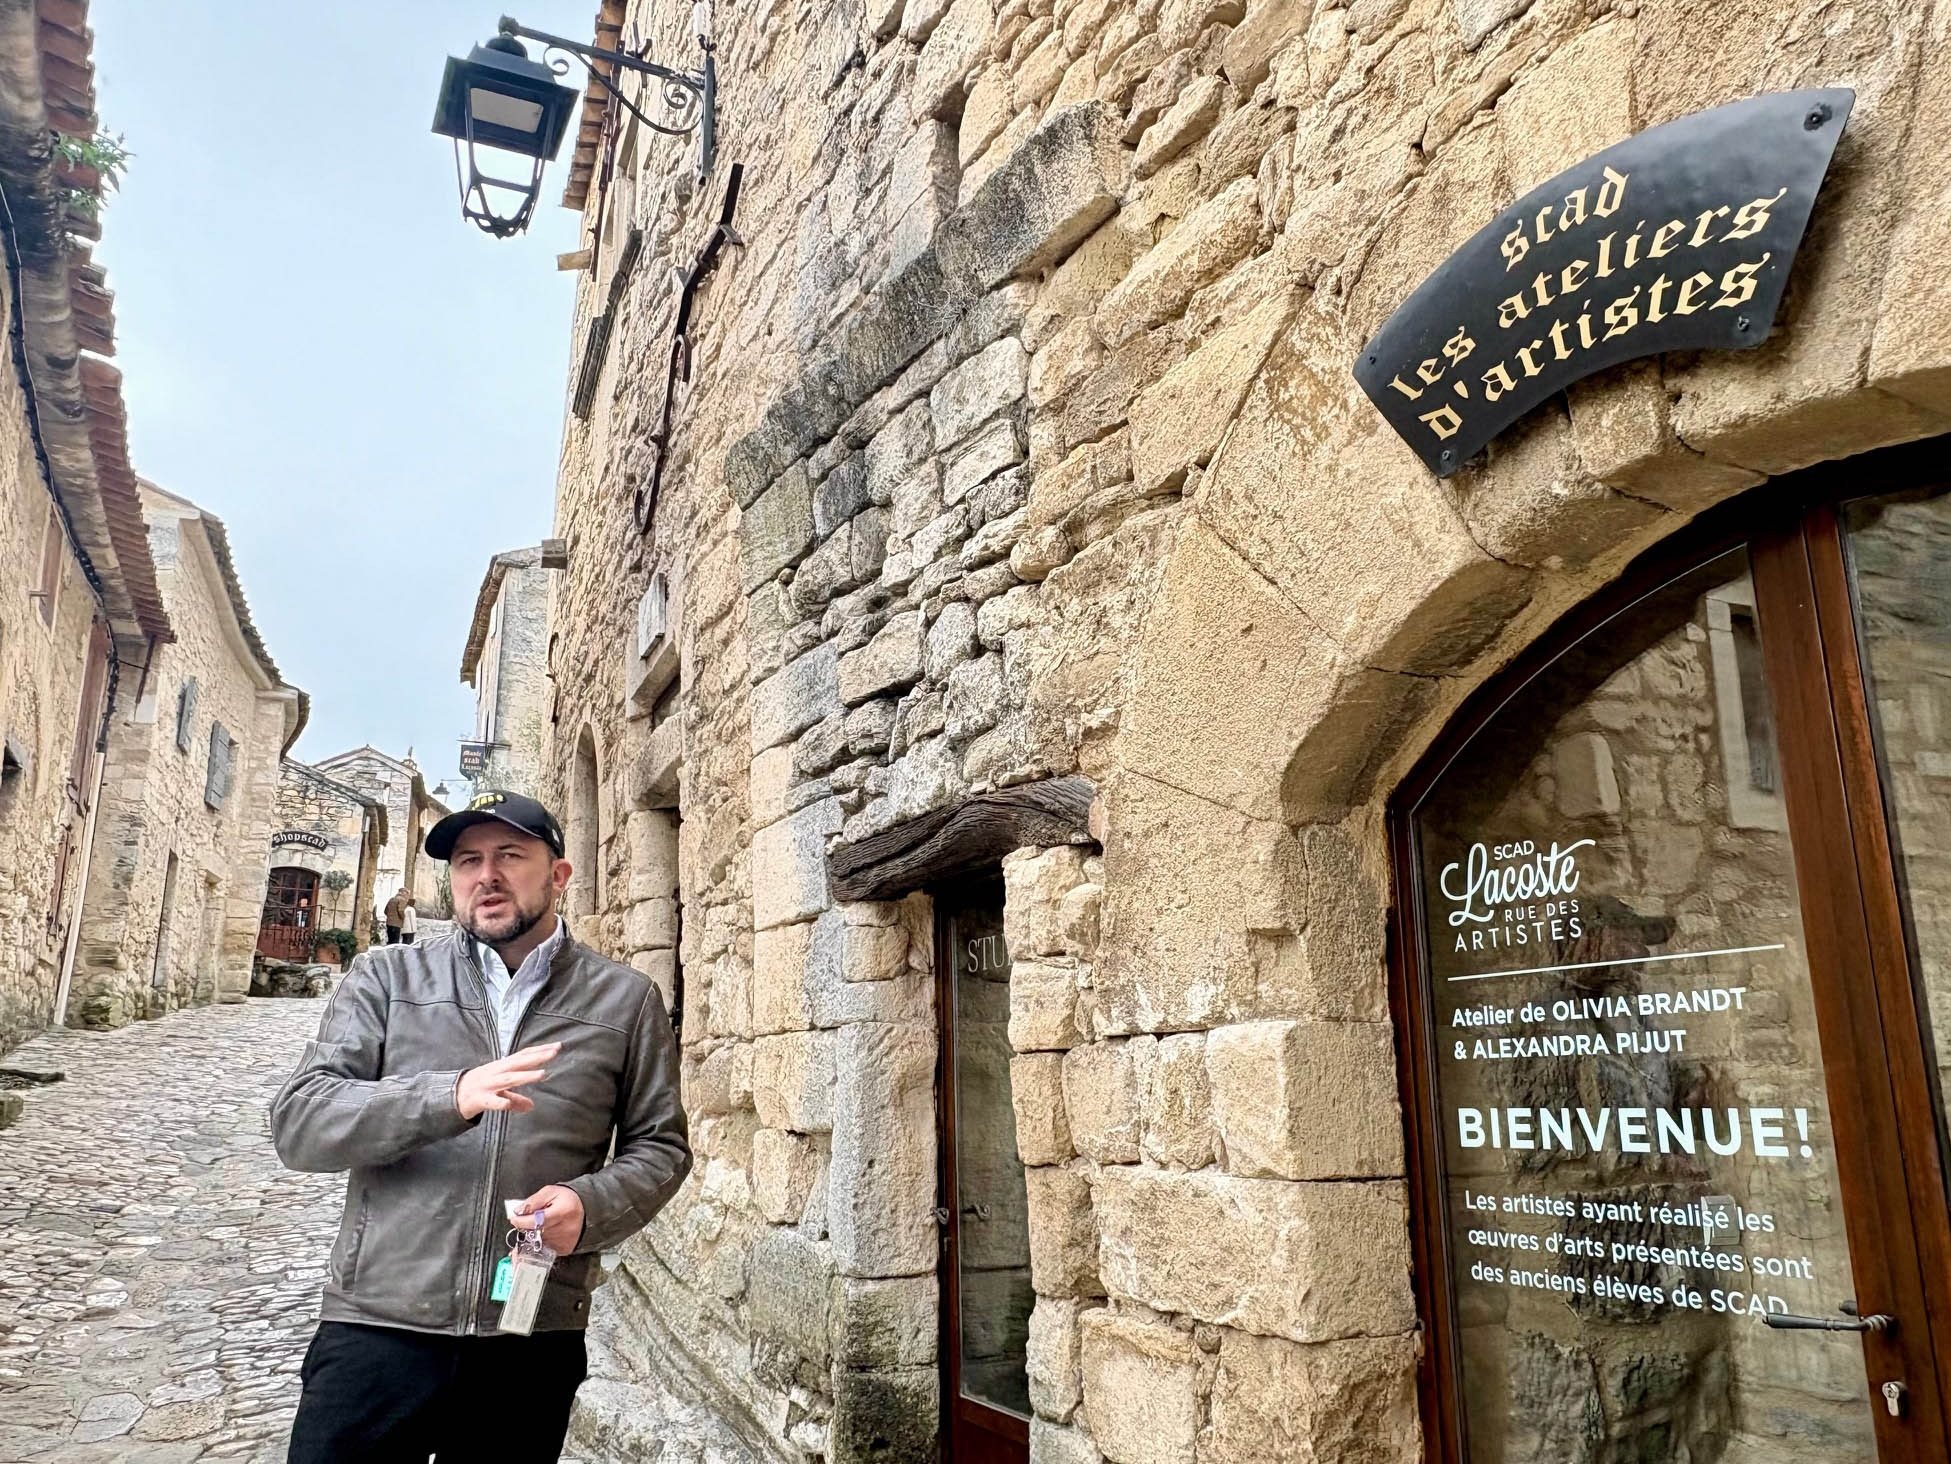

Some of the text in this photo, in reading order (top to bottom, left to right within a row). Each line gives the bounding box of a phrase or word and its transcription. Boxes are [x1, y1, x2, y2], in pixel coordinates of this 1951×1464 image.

[1500, 166, 1629, 272] scad
[1387, 187, 1788, 401] les ateliers
[1419, 252, 1771, 440] d'artistes
[1494, 840, 1535, 860] SCAD
[1440, 839, 1596, 926] Lacoste
[1505, 900, 1579, 922] RUE DES
[968, 934, 1014, 973] STU
[1455, 917, 1582, 953] ARTISTES
[1452, 987, 1747, 1027] Atelier de OLIVIA BRANDT
[1454, 1030, 1687, 1060] & ALEXANDRA PIJUT
[1458, 1107, 1813, 1158] BIENVENUE!
[1465, 1190, 1775, 1232] Les artistes ayant réalisé les
[1468, 1229, 1539, 1251] œuvres
[1611, 1240, 1745, 1272] présentées
[1752, 1256, 1813, 1280] sont
[1471, 1260, 1789, 1317] des anciens élèves de SCAD
